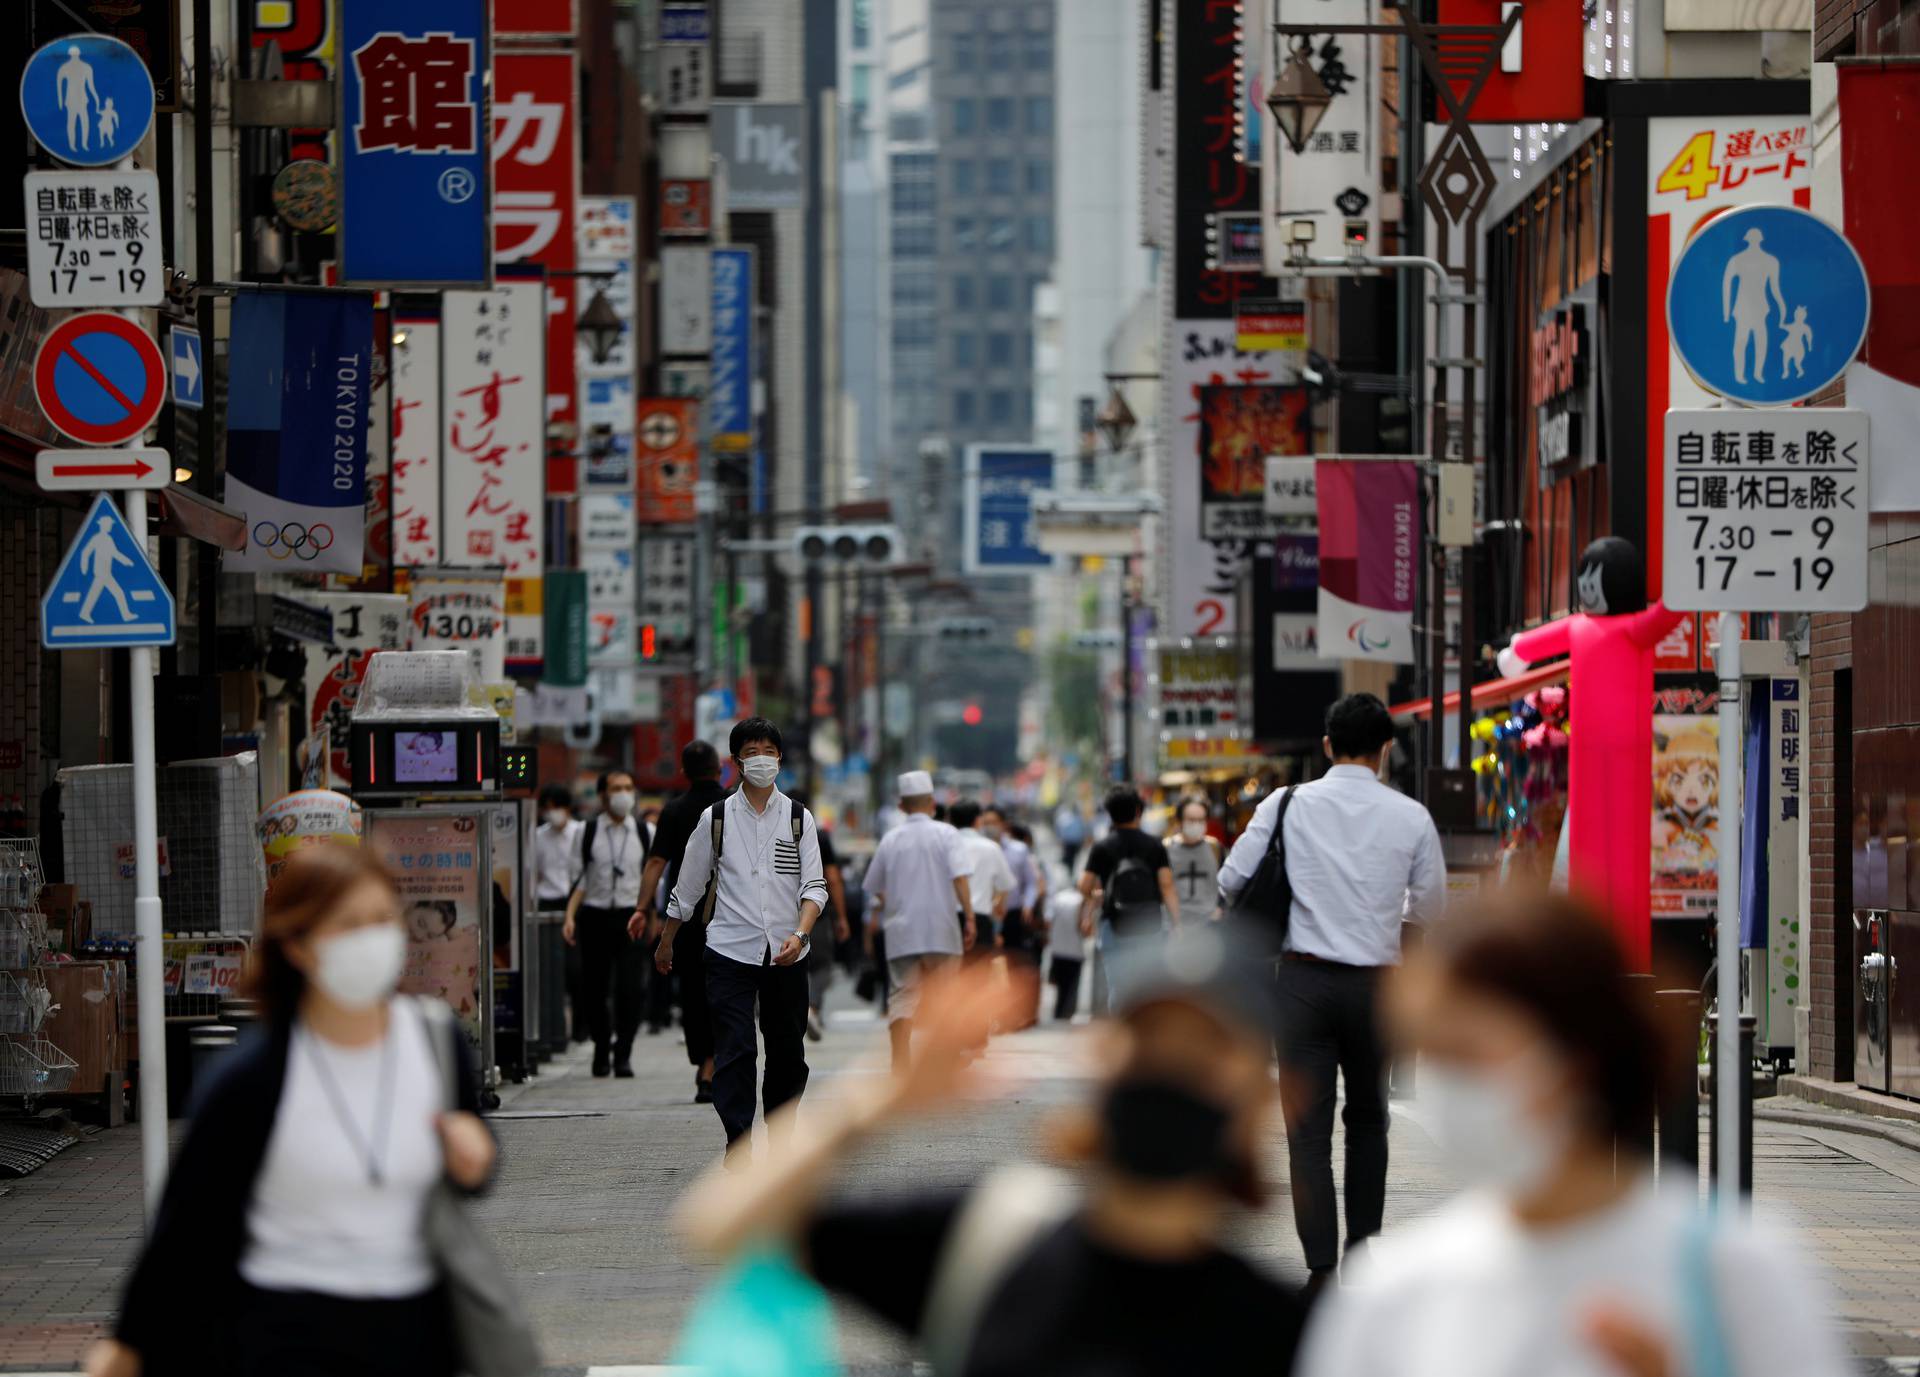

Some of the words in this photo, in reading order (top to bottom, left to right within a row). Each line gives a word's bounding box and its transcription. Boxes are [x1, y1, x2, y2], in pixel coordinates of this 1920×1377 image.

[352, 32, 478, 153] 館
[736, 106, 801, 176] hk
[1657, 131, 1720, 201] 4
[1722, 152, 1807, 191] レート
[37, 187, 149, 212] 自転車を除く
[48, 241, 89, 267] 7.30
[127, 241, 143, 265] 9
[49, 269, 78, 294] 17
[118, 269, 146, 293] 19
[335, 353, 359, 430] TOKYO
[332, 433, 356, 490] 2020
[1677, 430, 1858, 465] 自転車を除く
[1393, 501, 1411, 558] TOKYO
[1686, 515, 1755, 550] 7.30
[1811, 516, 1835, 550] 9
[1394, 559, 1411, 602] 2020
[1696, 556, 1737, 590] 17
[1794, 556, 1834, 591] 19
[1652, 688, 1719, 714] パチン
